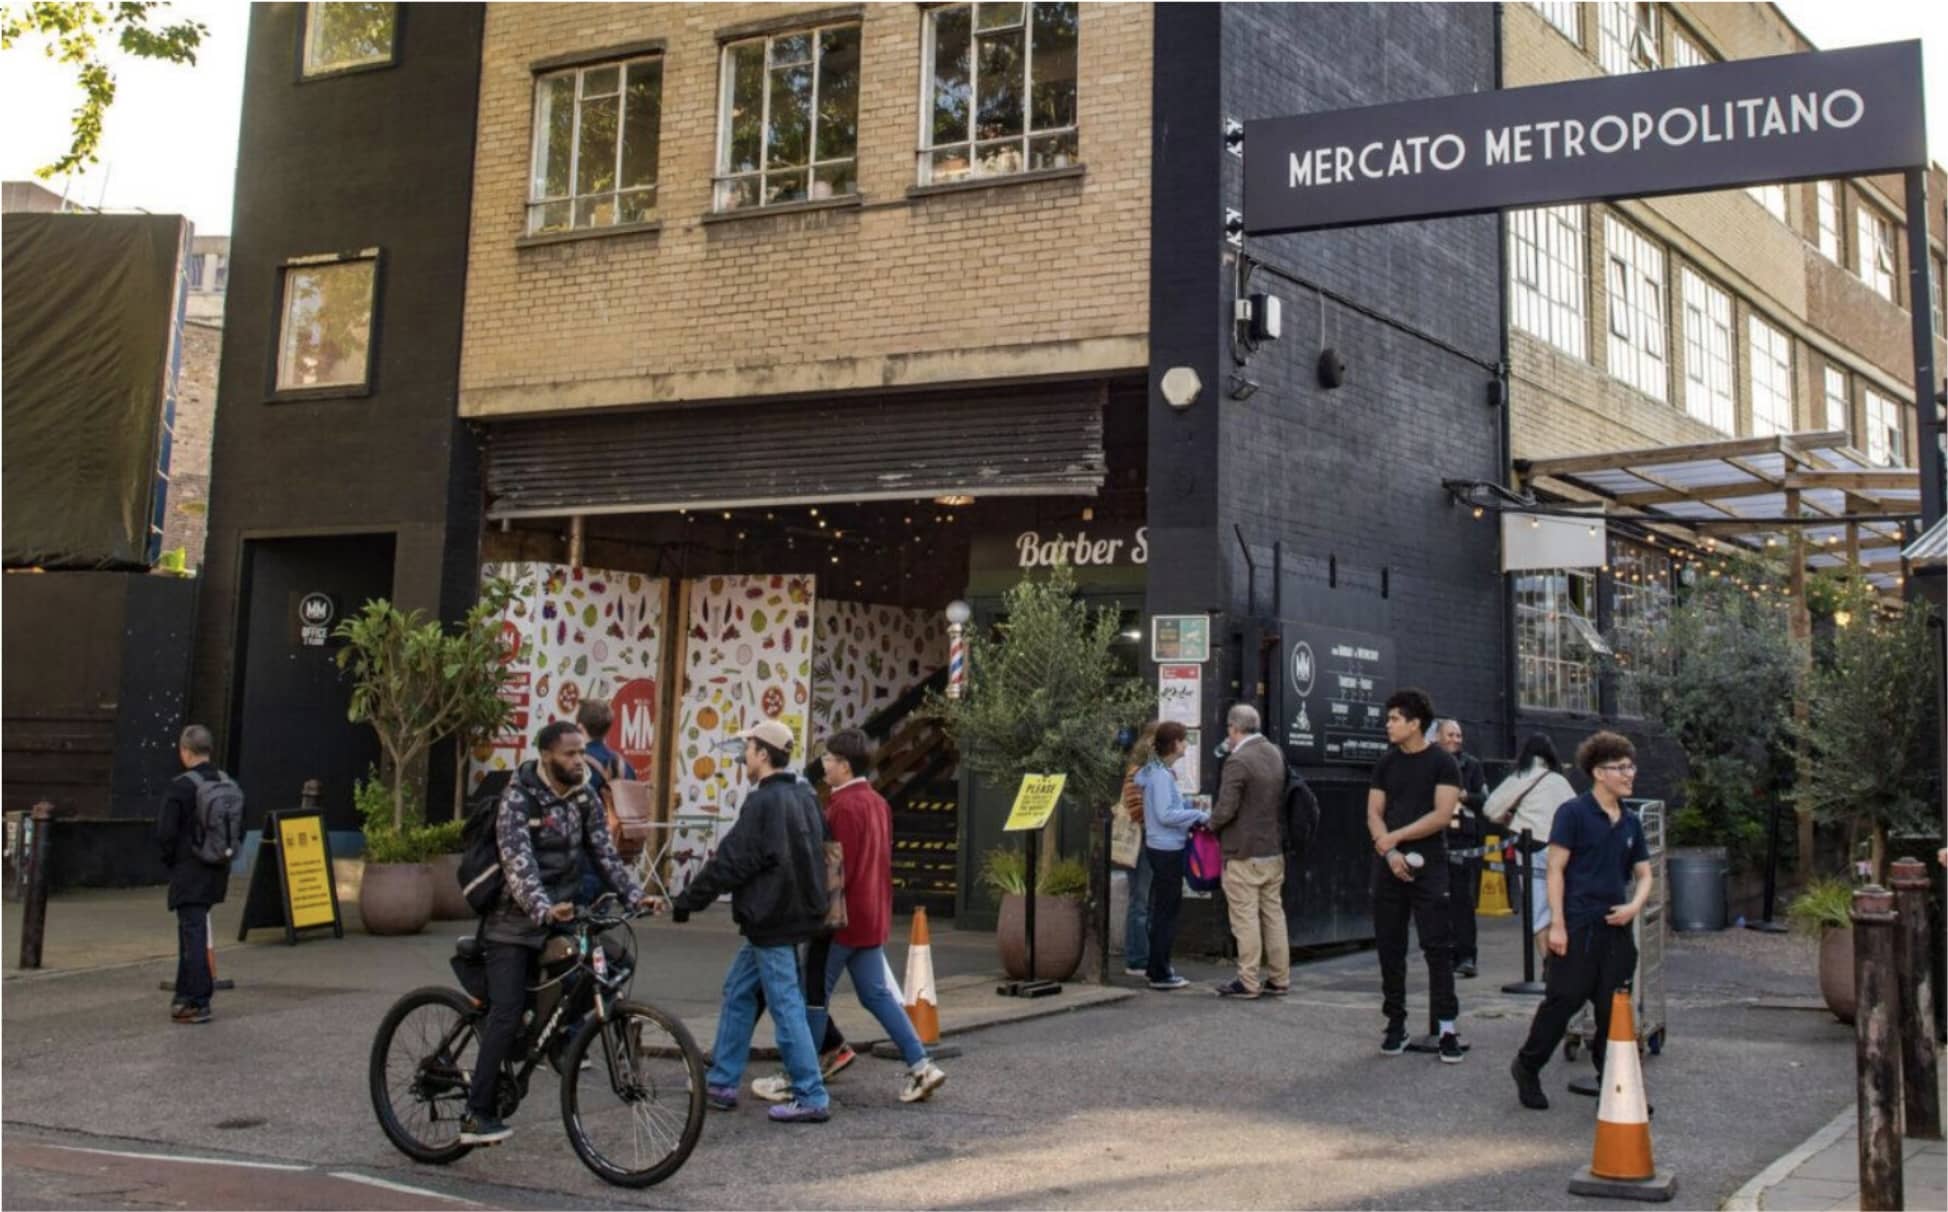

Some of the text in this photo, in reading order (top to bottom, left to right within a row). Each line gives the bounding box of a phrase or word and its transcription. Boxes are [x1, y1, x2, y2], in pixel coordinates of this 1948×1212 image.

[1288, 88, 1865, 188] MERCATO METROPOLITANO
[1016, 531, 1123, 567] Barber
[1024, 784, 1057, 793] PLEASE
